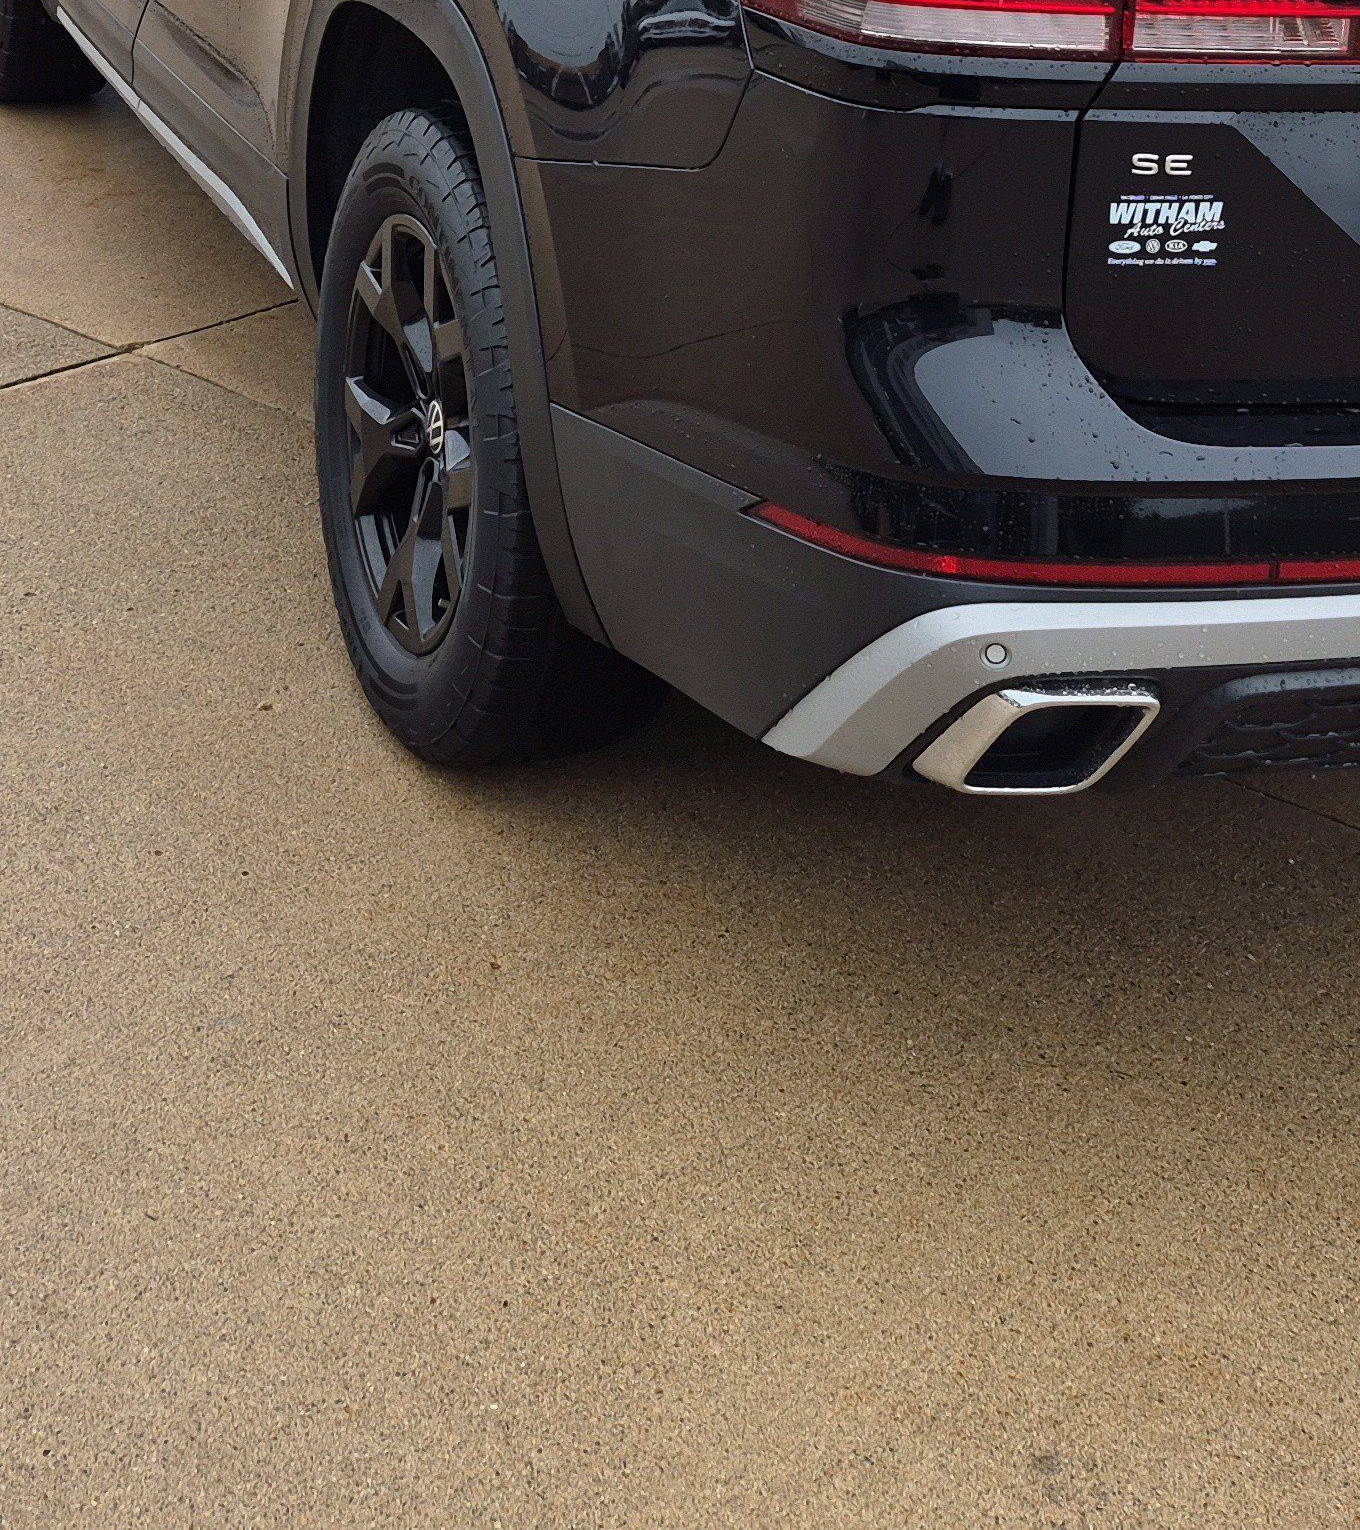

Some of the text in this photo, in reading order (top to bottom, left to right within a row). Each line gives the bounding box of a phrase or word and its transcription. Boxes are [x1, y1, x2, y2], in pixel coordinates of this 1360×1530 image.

[1131, 153, 1193, 176] SE
[1109, 201, 1224, 225] WITHAM
[1124, 218, 1225, 238] Auto Centers
